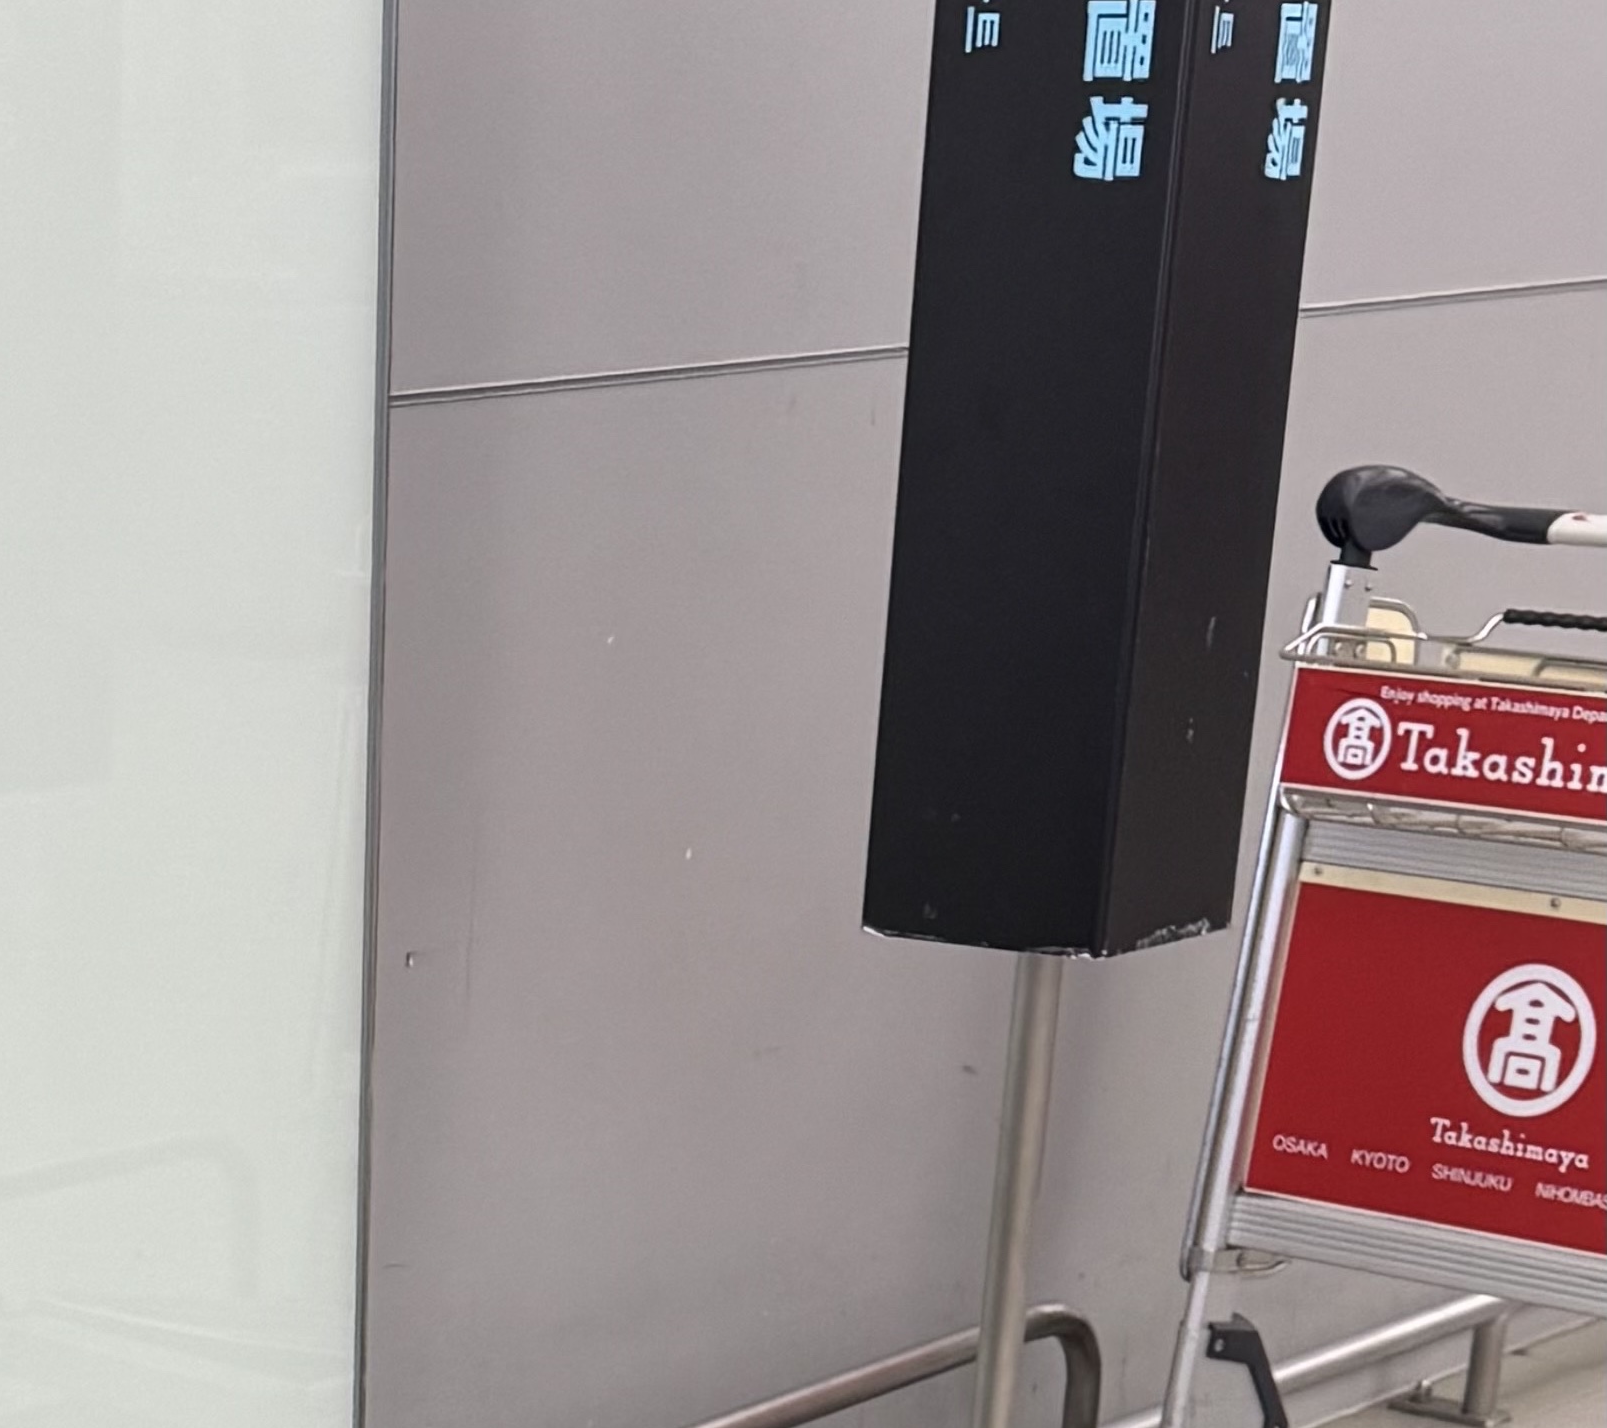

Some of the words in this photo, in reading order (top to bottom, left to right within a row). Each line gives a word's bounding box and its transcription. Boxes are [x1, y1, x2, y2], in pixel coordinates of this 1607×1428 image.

[965, 0, 1000, 53] 트
[1380, 685, 1414, 705] Enjoy
[1417, 691, 1472, 712] shopping
[1474, 697, 1489, 710] at
[1490, 697, 1570, 721] Takashimaya
[1272, 1133, 1329, 1160] OSAKA
[1350, 1148, 1411, 1174] KYOTO
[1431, 1162, 1514, 1193] SHINJUKU
[1430, 1116, 1590, 1173] Takashimaya
